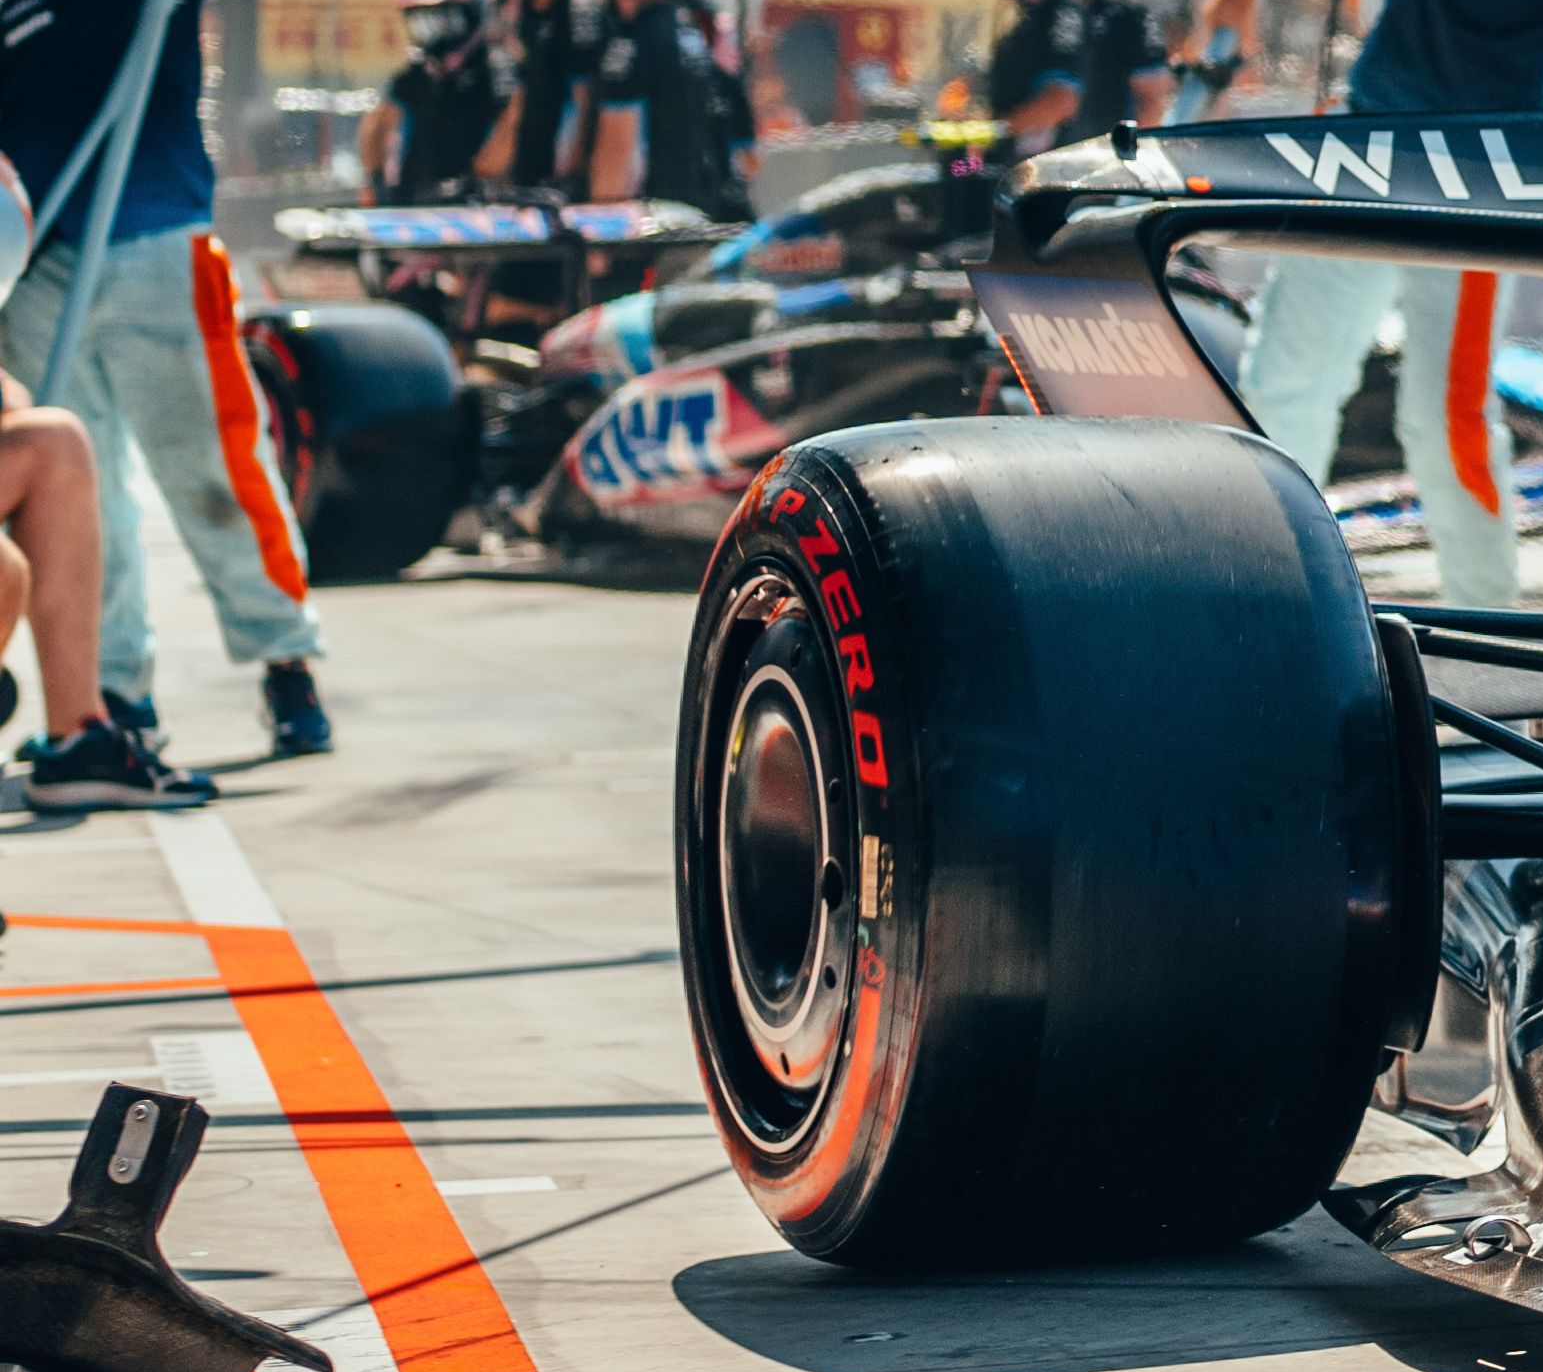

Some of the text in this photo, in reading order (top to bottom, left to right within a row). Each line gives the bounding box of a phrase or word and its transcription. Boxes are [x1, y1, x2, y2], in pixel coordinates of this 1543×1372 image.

[1009, 303, 1190, 380] KOMATSU
[769, 487, 890, 789] P ZERO
